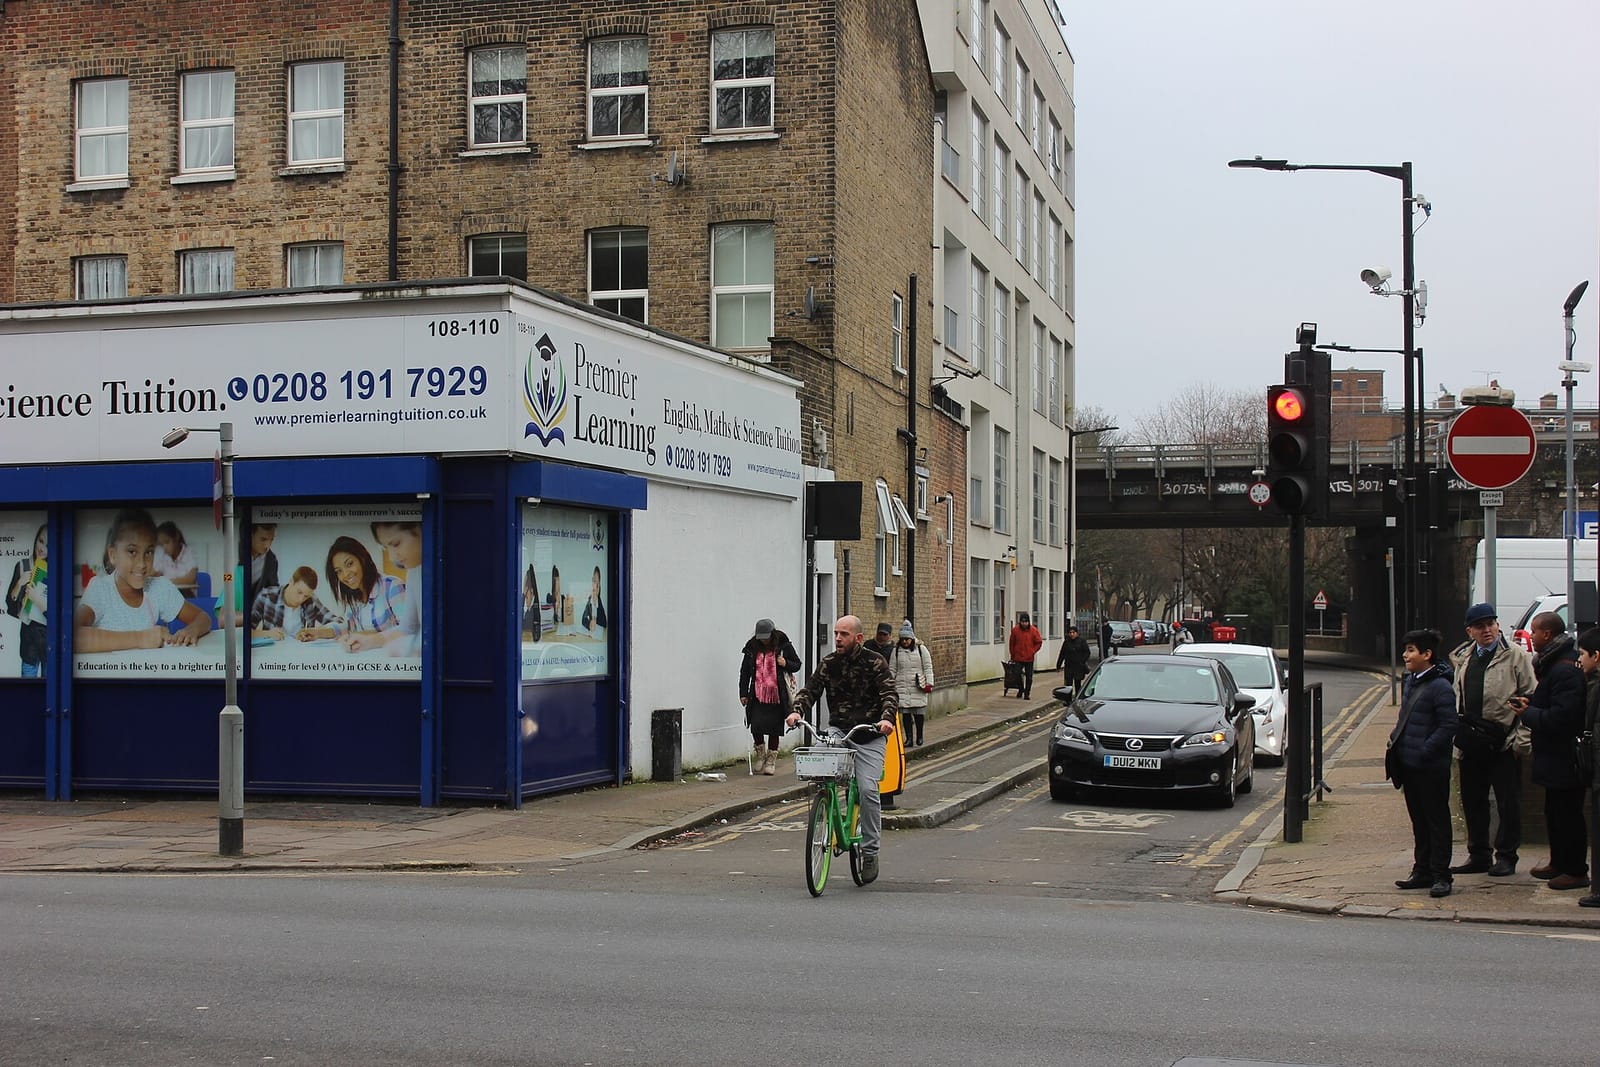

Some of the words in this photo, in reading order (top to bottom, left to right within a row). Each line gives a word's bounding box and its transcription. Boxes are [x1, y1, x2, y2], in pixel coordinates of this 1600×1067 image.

[428, 318, 499, 337] 108-110
[253, 371, 327, 403] 0208
[340, 369, 392, 400] 191
[406, 365, 488, 398] 7929
[574, 342, 638, 400] Premier
[102, 378, 226, 415] Tuition.
[254, 406, 487, 427] www.premierlearningtuition.co.uk
[573, 394, 656, 466] Learning
[663, 398, 702, 438] English,
[704, 408, 732, 439] Maths
[733, 416, 741, 441] &
[743, 418, 774, 448] Science
[774, 426, 801, 454] Tuition
[675, 446, 695, 471] 0208
[697, 450, 710, 474] 191
[713, 453, 731, 478] 7929
[77, 662, 119, 671] Education
[120, 662, 128, 671] is
[129, 662, 142, 671] the
[144, 662, 158, 673] key
[161, 663, 170, 671] to
[178, 662, 212, 673] brighter
[214, 662, 241, 672] fute
[258, 663, 287, 672] Aiming
[288, 662, 300, 671] for
[301, 662, 319, 671] level
[321, 663, 326, 671] 9
[347, 662, 355, 671] in
[357, 663, 382, 671] GCSE
[383, 663, 392, 672] &
[1113, 757, 1136, 767] DU12
[1137, 758, 1158, 768] WKN
